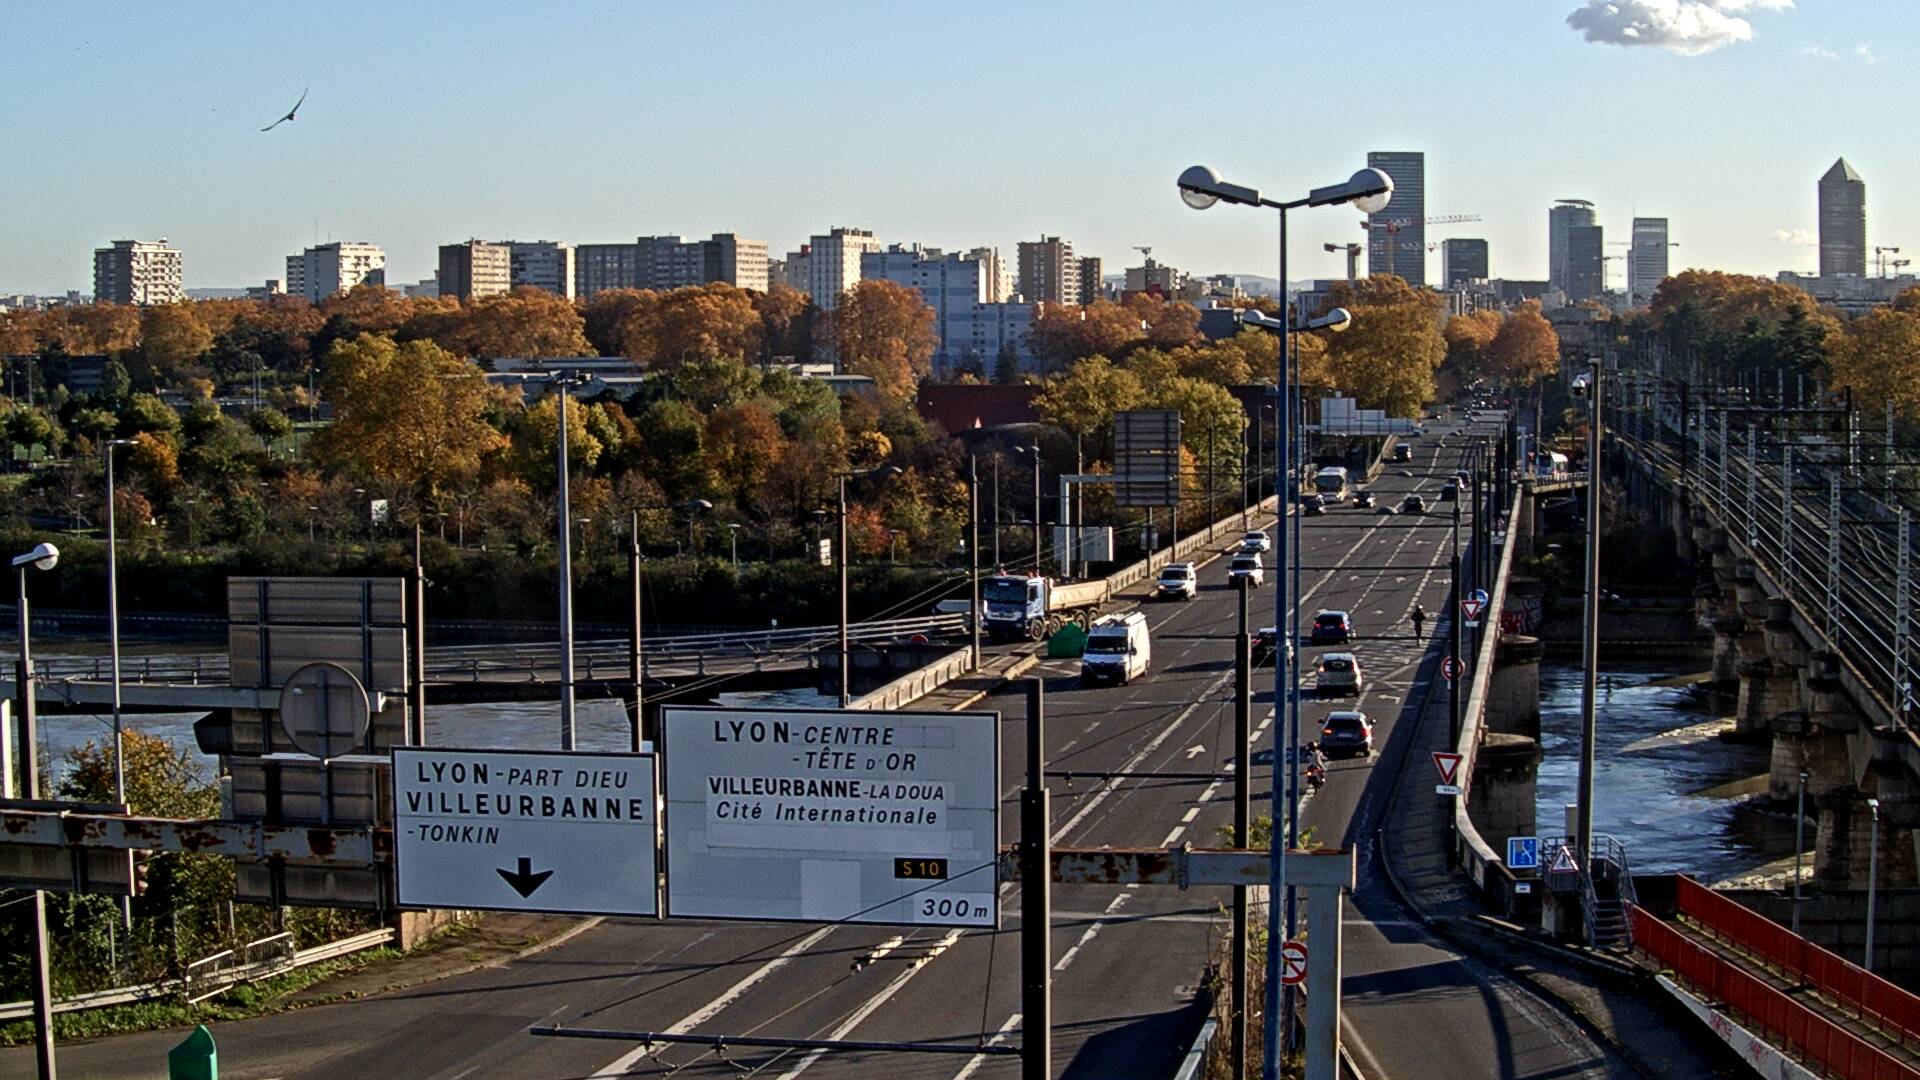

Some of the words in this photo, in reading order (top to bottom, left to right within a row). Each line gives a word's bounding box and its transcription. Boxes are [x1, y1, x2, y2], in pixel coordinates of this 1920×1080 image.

[575, 770, 628, 789] DIEU
[895, 785, 944, 801] DOUA
[406, 791, 643, 820] VILLEURBANNE
[716, 800, 762, 820] Cité
[775, 803, 937, 825] Internationale
